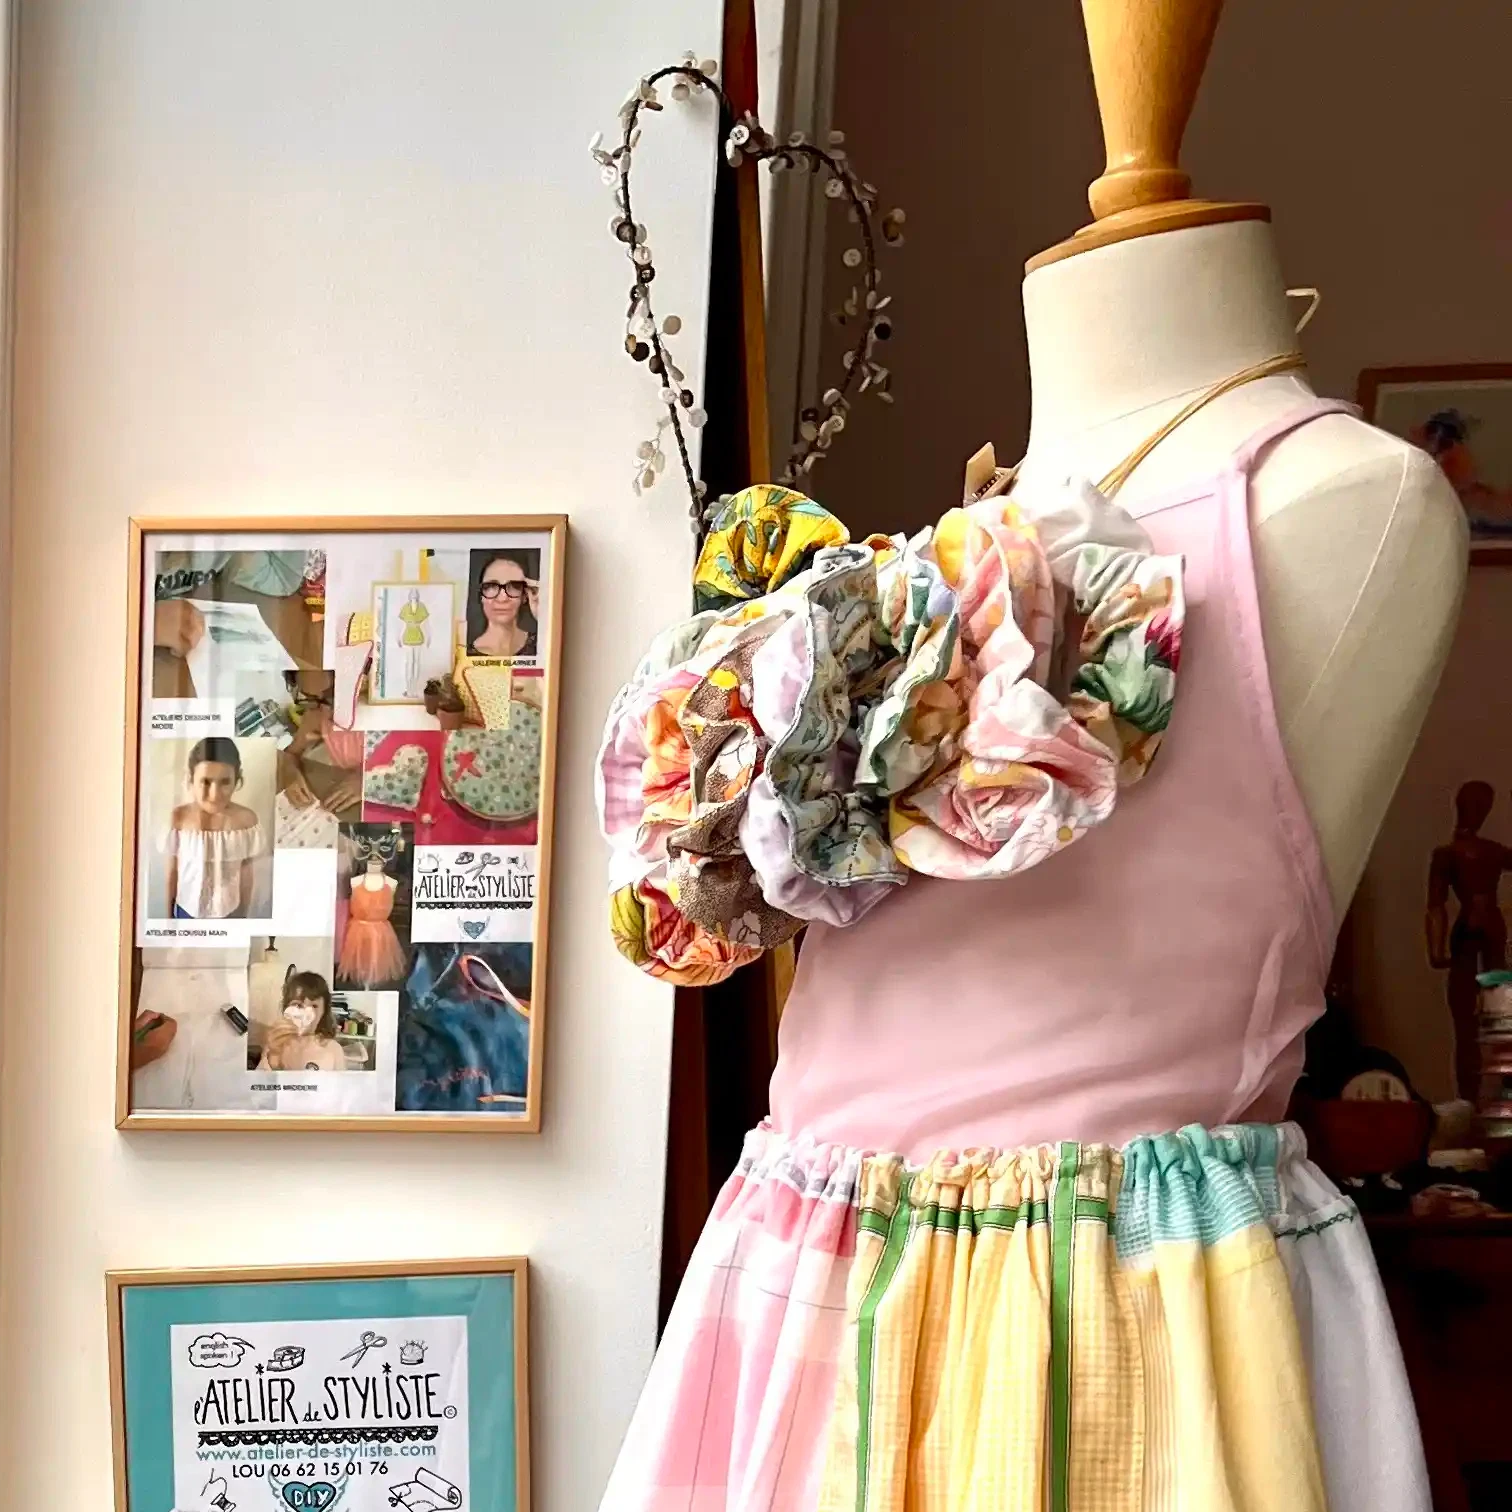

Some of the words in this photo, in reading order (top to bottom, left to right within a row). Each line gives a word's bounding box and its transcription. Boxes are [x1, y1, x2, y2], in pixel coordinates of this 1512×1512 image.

[478, 870, 535, 898] STYLISTE
[303, 1401, 322, 1422] de
[323, 1363, 442, 1420] STYLISTE
[196, 1442, 437, 1461] www.atelier-de-styliste.com
[232, 1464, 265, 1478] LOU
[271, 1463, 290, 1477] 06
[296, 1462, 316, 1476] 62
[324, 1462, 340, 1476] 15
[345, 1461, 362, 1475] 01
[370, 1460, 388, 1475] 76
[294, 1490, 330, 1507] DIY
